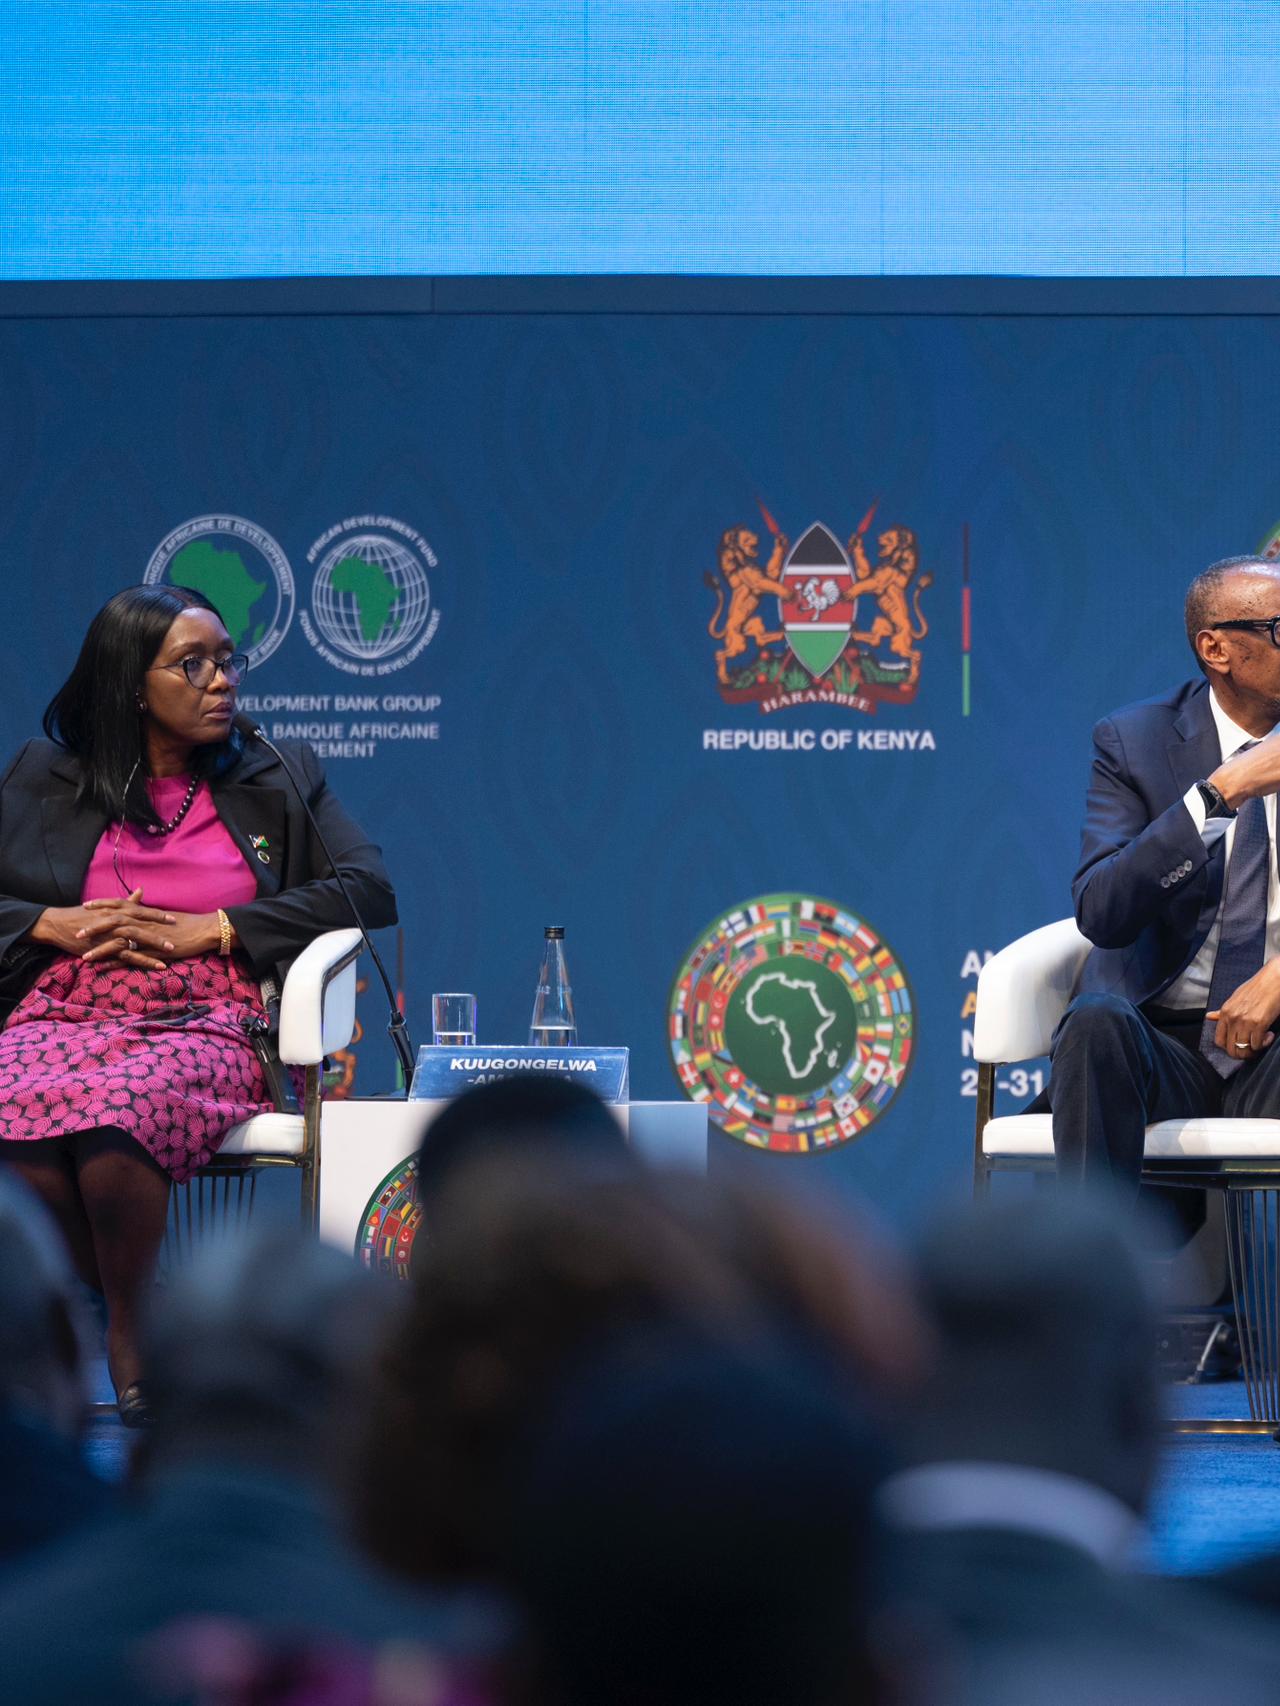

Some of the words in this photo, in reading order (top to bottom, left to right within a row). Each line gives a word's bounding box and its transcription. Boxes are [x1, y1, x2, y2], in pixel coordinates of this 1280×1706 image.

[165, 519, 216, 551] AFRICAINE
[217, 519, 231, 530] DE
[306, 523, 343, 564] AFRICAN
[342, 514, 419, 541] DEVELOPMENT
[416, 537, 438, 568] FUND
[360, 664, 376, 677] DE
[235, 694, 331, 712] VELOPMENT
[334, 694, 380, 712] BANK
[382, 694, 442, 712] GROUP
[762, 689, 870, 713] HARAMBEE
[272, 721, 345, 740] BANQUE
[349, 721, 441, 740] AFRICAINE
[702, 729, 816, 750] REPUBLIC
[820, 729, 853, 750] OF
[858, 730, 936, 751] KENYA
[450, 1058, 597, 1071] KUUGONGELWA
[961, 1068, 1043, 1097] 2-31
